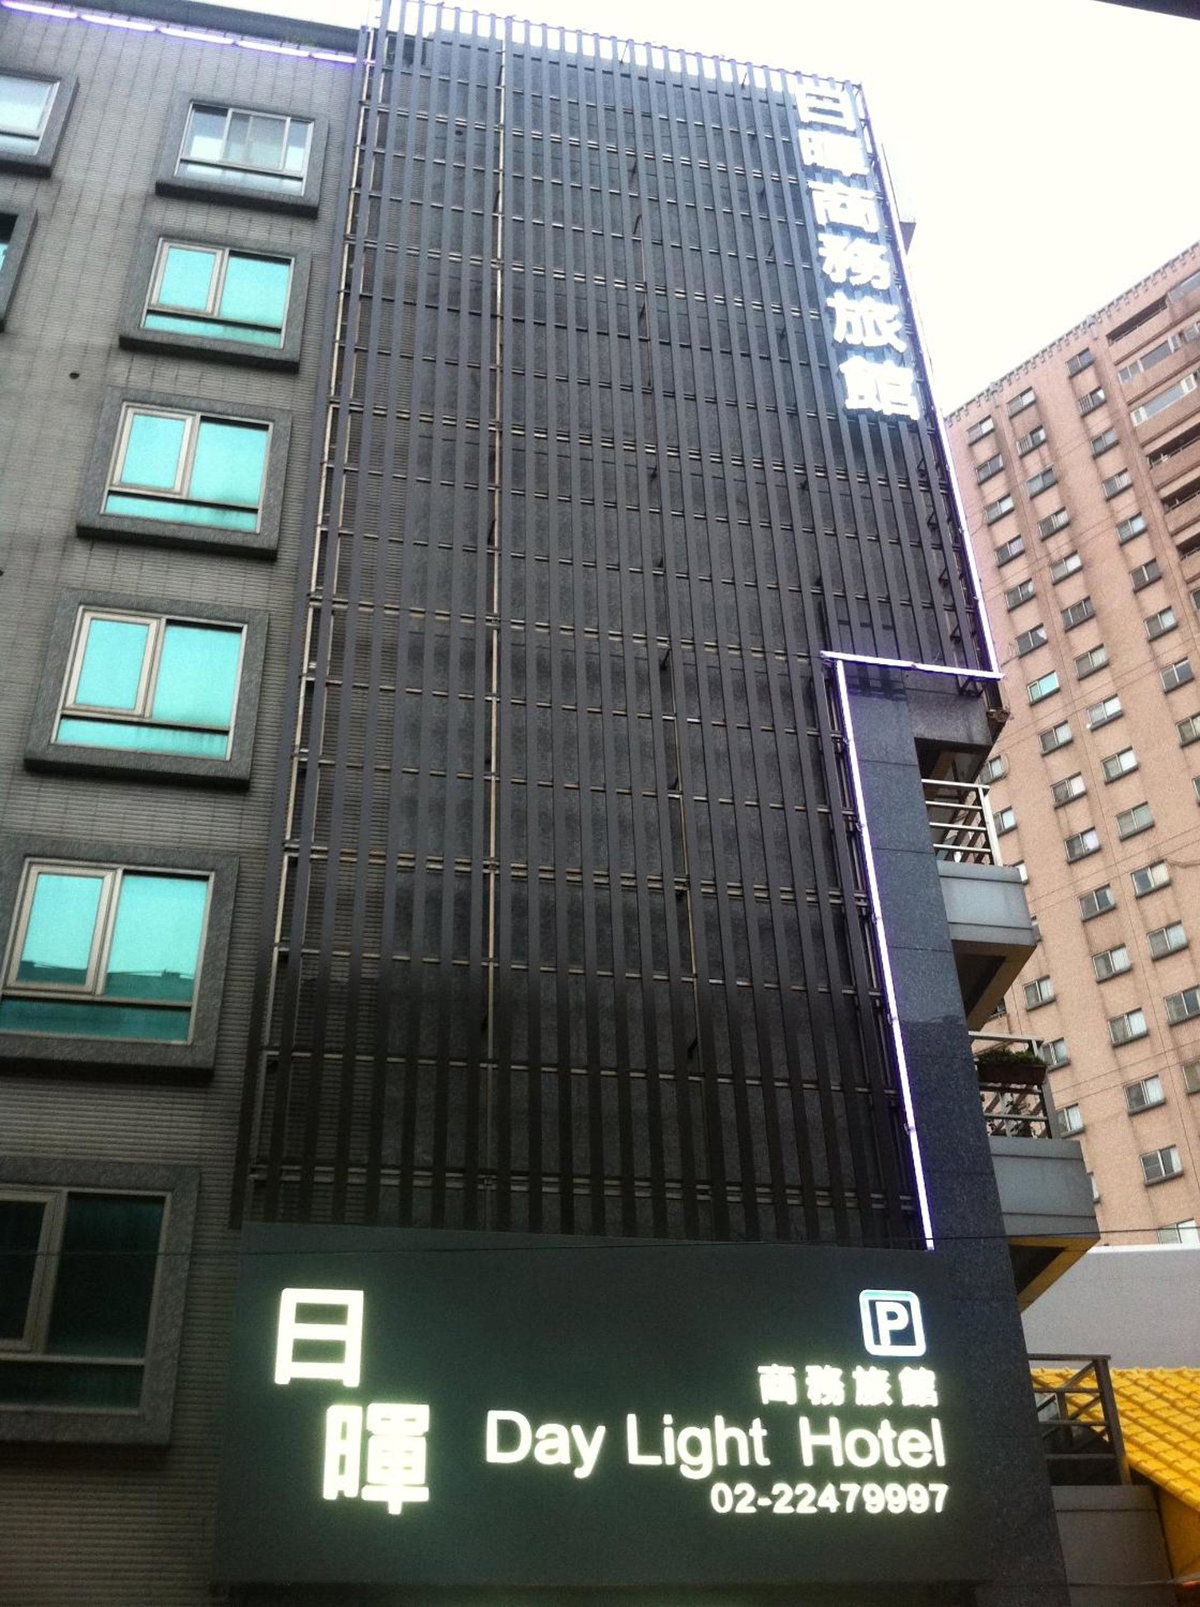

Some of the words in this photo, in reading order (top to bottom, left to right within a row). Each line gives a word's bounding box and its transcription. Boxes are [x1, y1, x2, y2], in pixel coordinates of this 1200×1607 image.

[875, 1301, 909, 1346] P
[757, 1364, 939, 1407] 商務旅館
[486, 1410, 607, 1479] Day
[626, 1413, 771, 1480] Light
[799, 1415, 946, 1468] Hotel
[710, 1482, 949, 1514] 02-22479997
